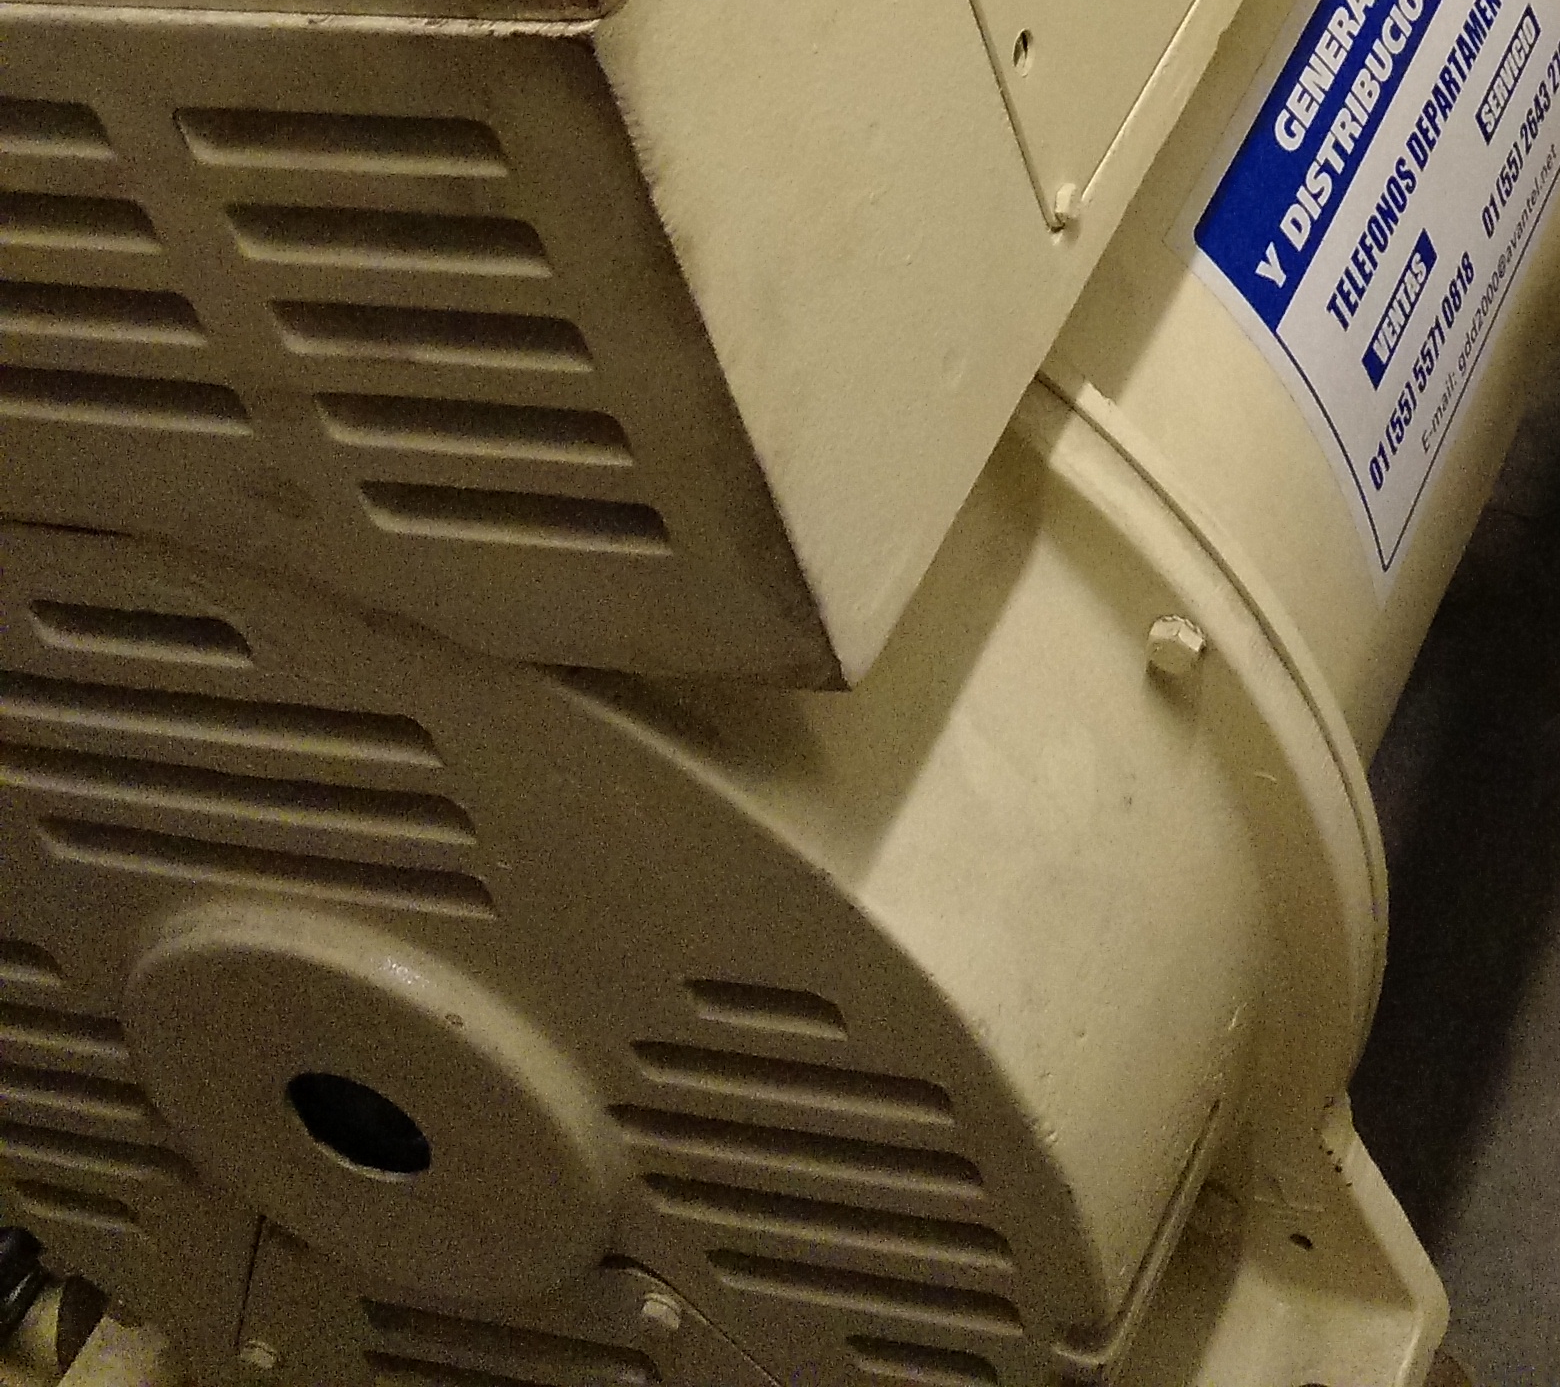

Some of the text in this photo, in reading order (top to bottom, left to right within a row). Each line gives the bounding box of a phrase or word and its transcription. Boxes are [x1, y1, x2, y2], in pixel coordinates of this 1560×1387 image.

[1479, 12, 1537, 134] SERVICIO
[1480, 195, 1501, 240] 01
[1495, 138, 1525, 206] (55)
[1519, 79, 1552, 156] 2643
[1255, 241, 1287, 289] Y
[1325, 156, 1417, 332] TELEFONOS
[1372, 251, 1428, 365] VENTAS
[1420, 143, 1558, 455] E-mail: gdd2000@avantel.net
[1368, 250, 1476, 491] 01 (55) 5571 0818
